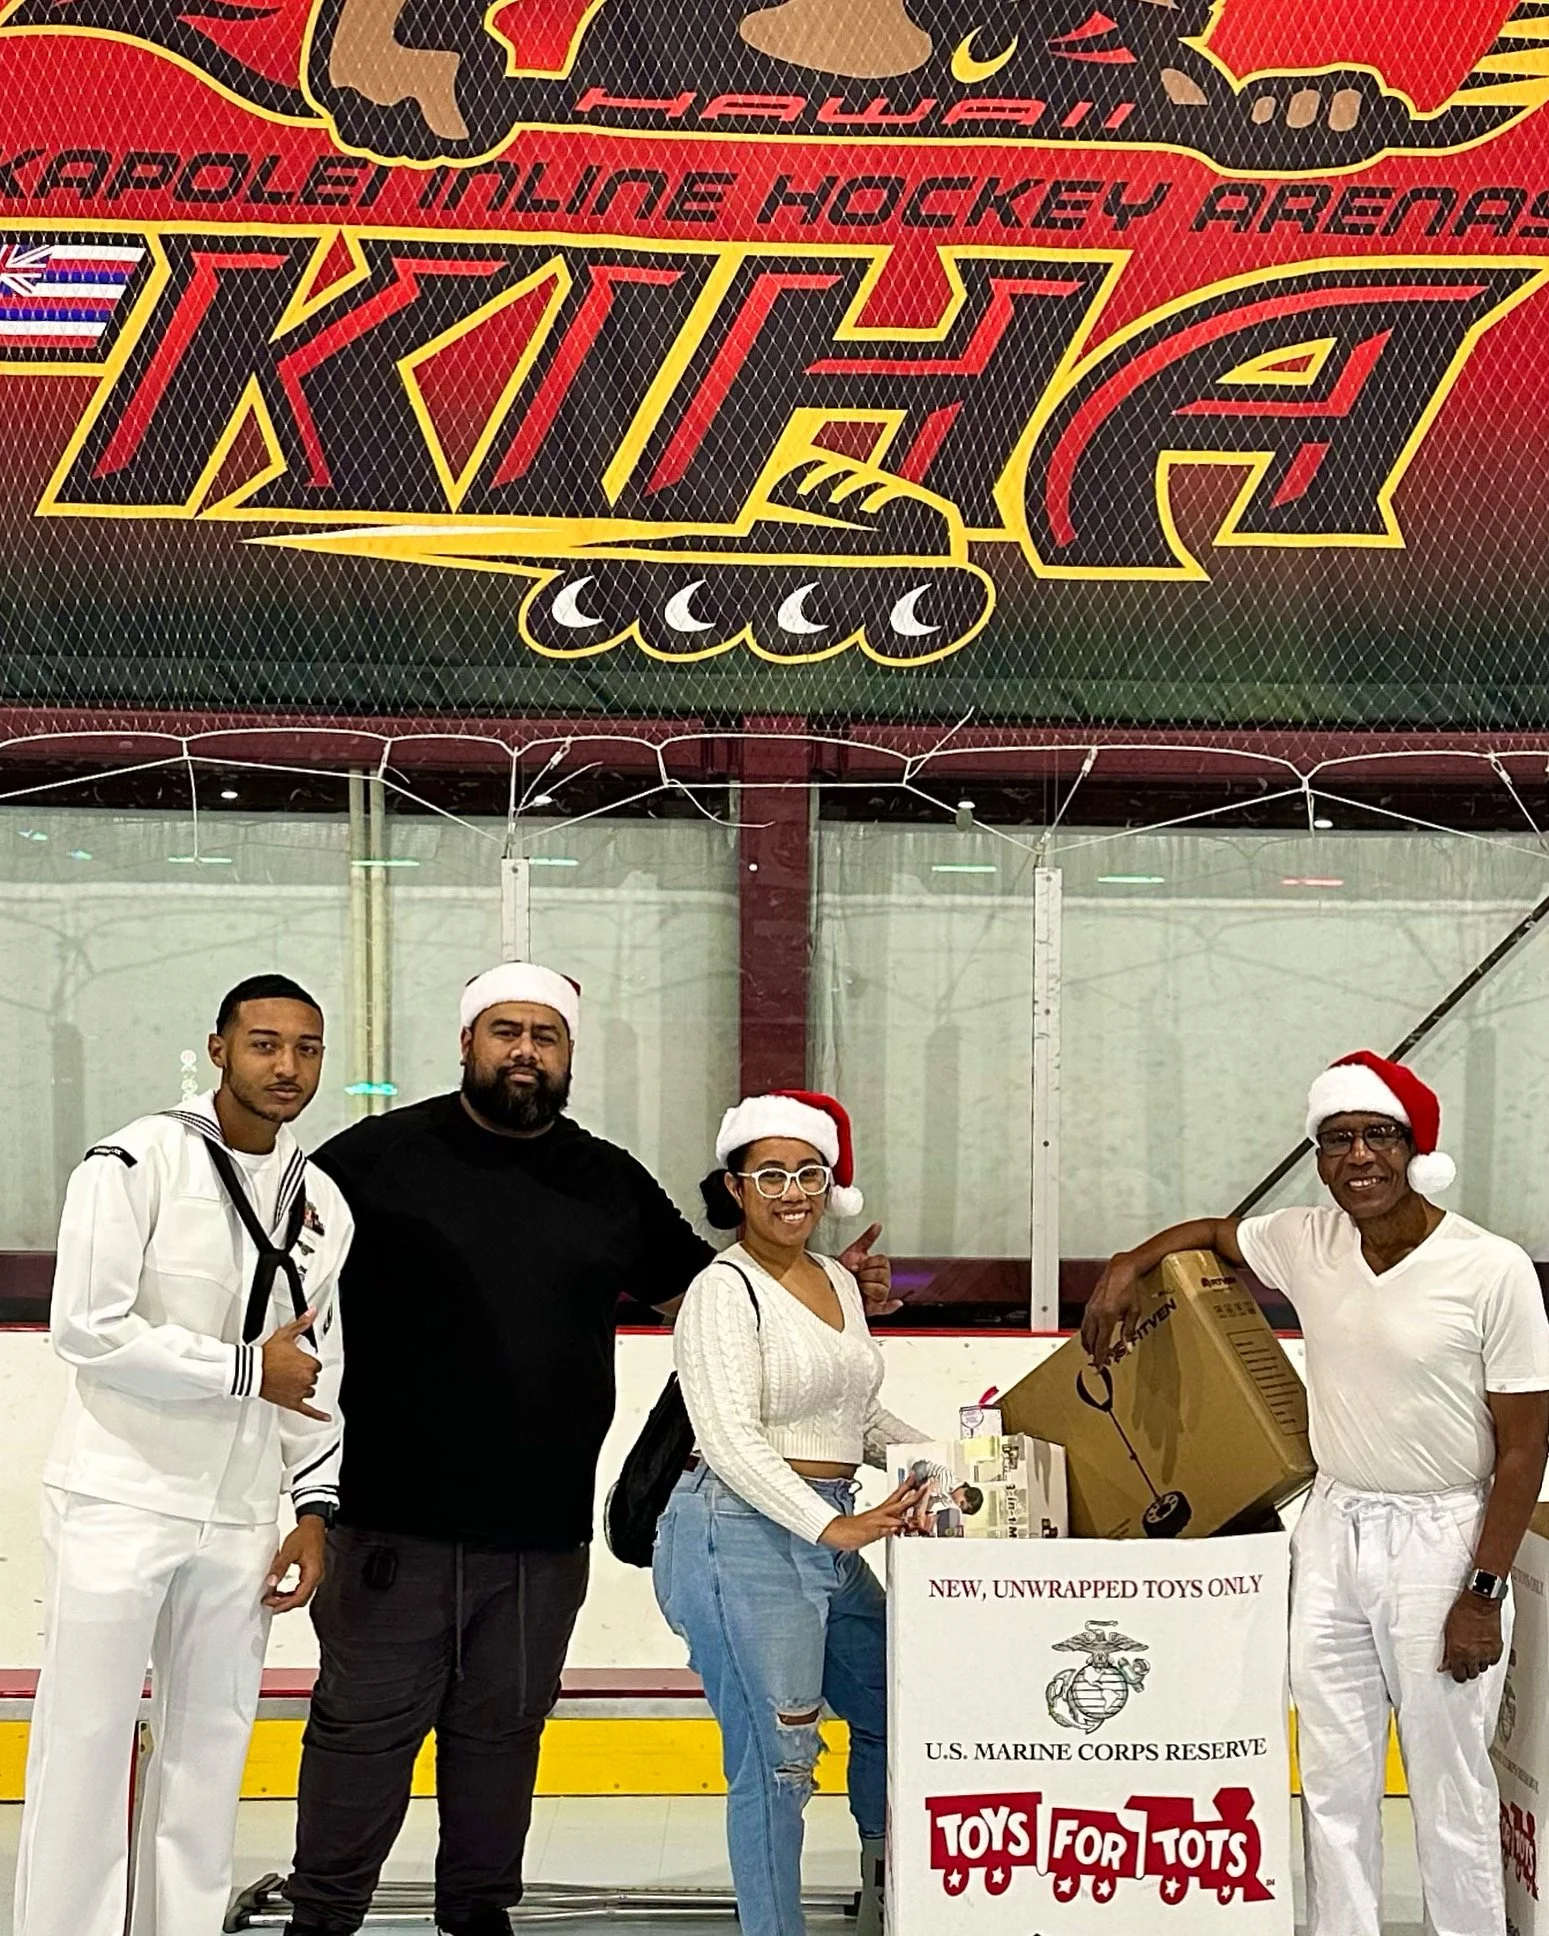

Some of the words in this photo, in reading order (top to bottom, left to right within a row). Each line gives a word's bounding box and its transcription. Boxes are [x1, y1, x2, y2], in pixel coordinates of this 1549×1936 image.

[574, 87, 1136, 129] HAWAII
[0, 148, 389, 208] KAPOLEI
[417, 160, 739, 223] INLINE
[756, 174, 1174, 232] HOCKEY
[928, 1578, 987, 1601] NEW,
[993, 1579, 1139, 1599] UNWRAPPED
[1143, 1579, 1203, 1599] TOYS
[1208, 1574, 1264, 1597] ONLY
[925, 1742, 968, 1761] U.S.
[974, 1743, 1073, 1762] MARINE
[1078, 1743, 1160, 1762] CORPS
[1165, 1737, 1267, 1762] RESERVE
[936, 1805, 1030, 1859] TOYS
[1052, 1818, 1128, 1871] FOR
[1151, 1827, 1248, 1878] TOTS
